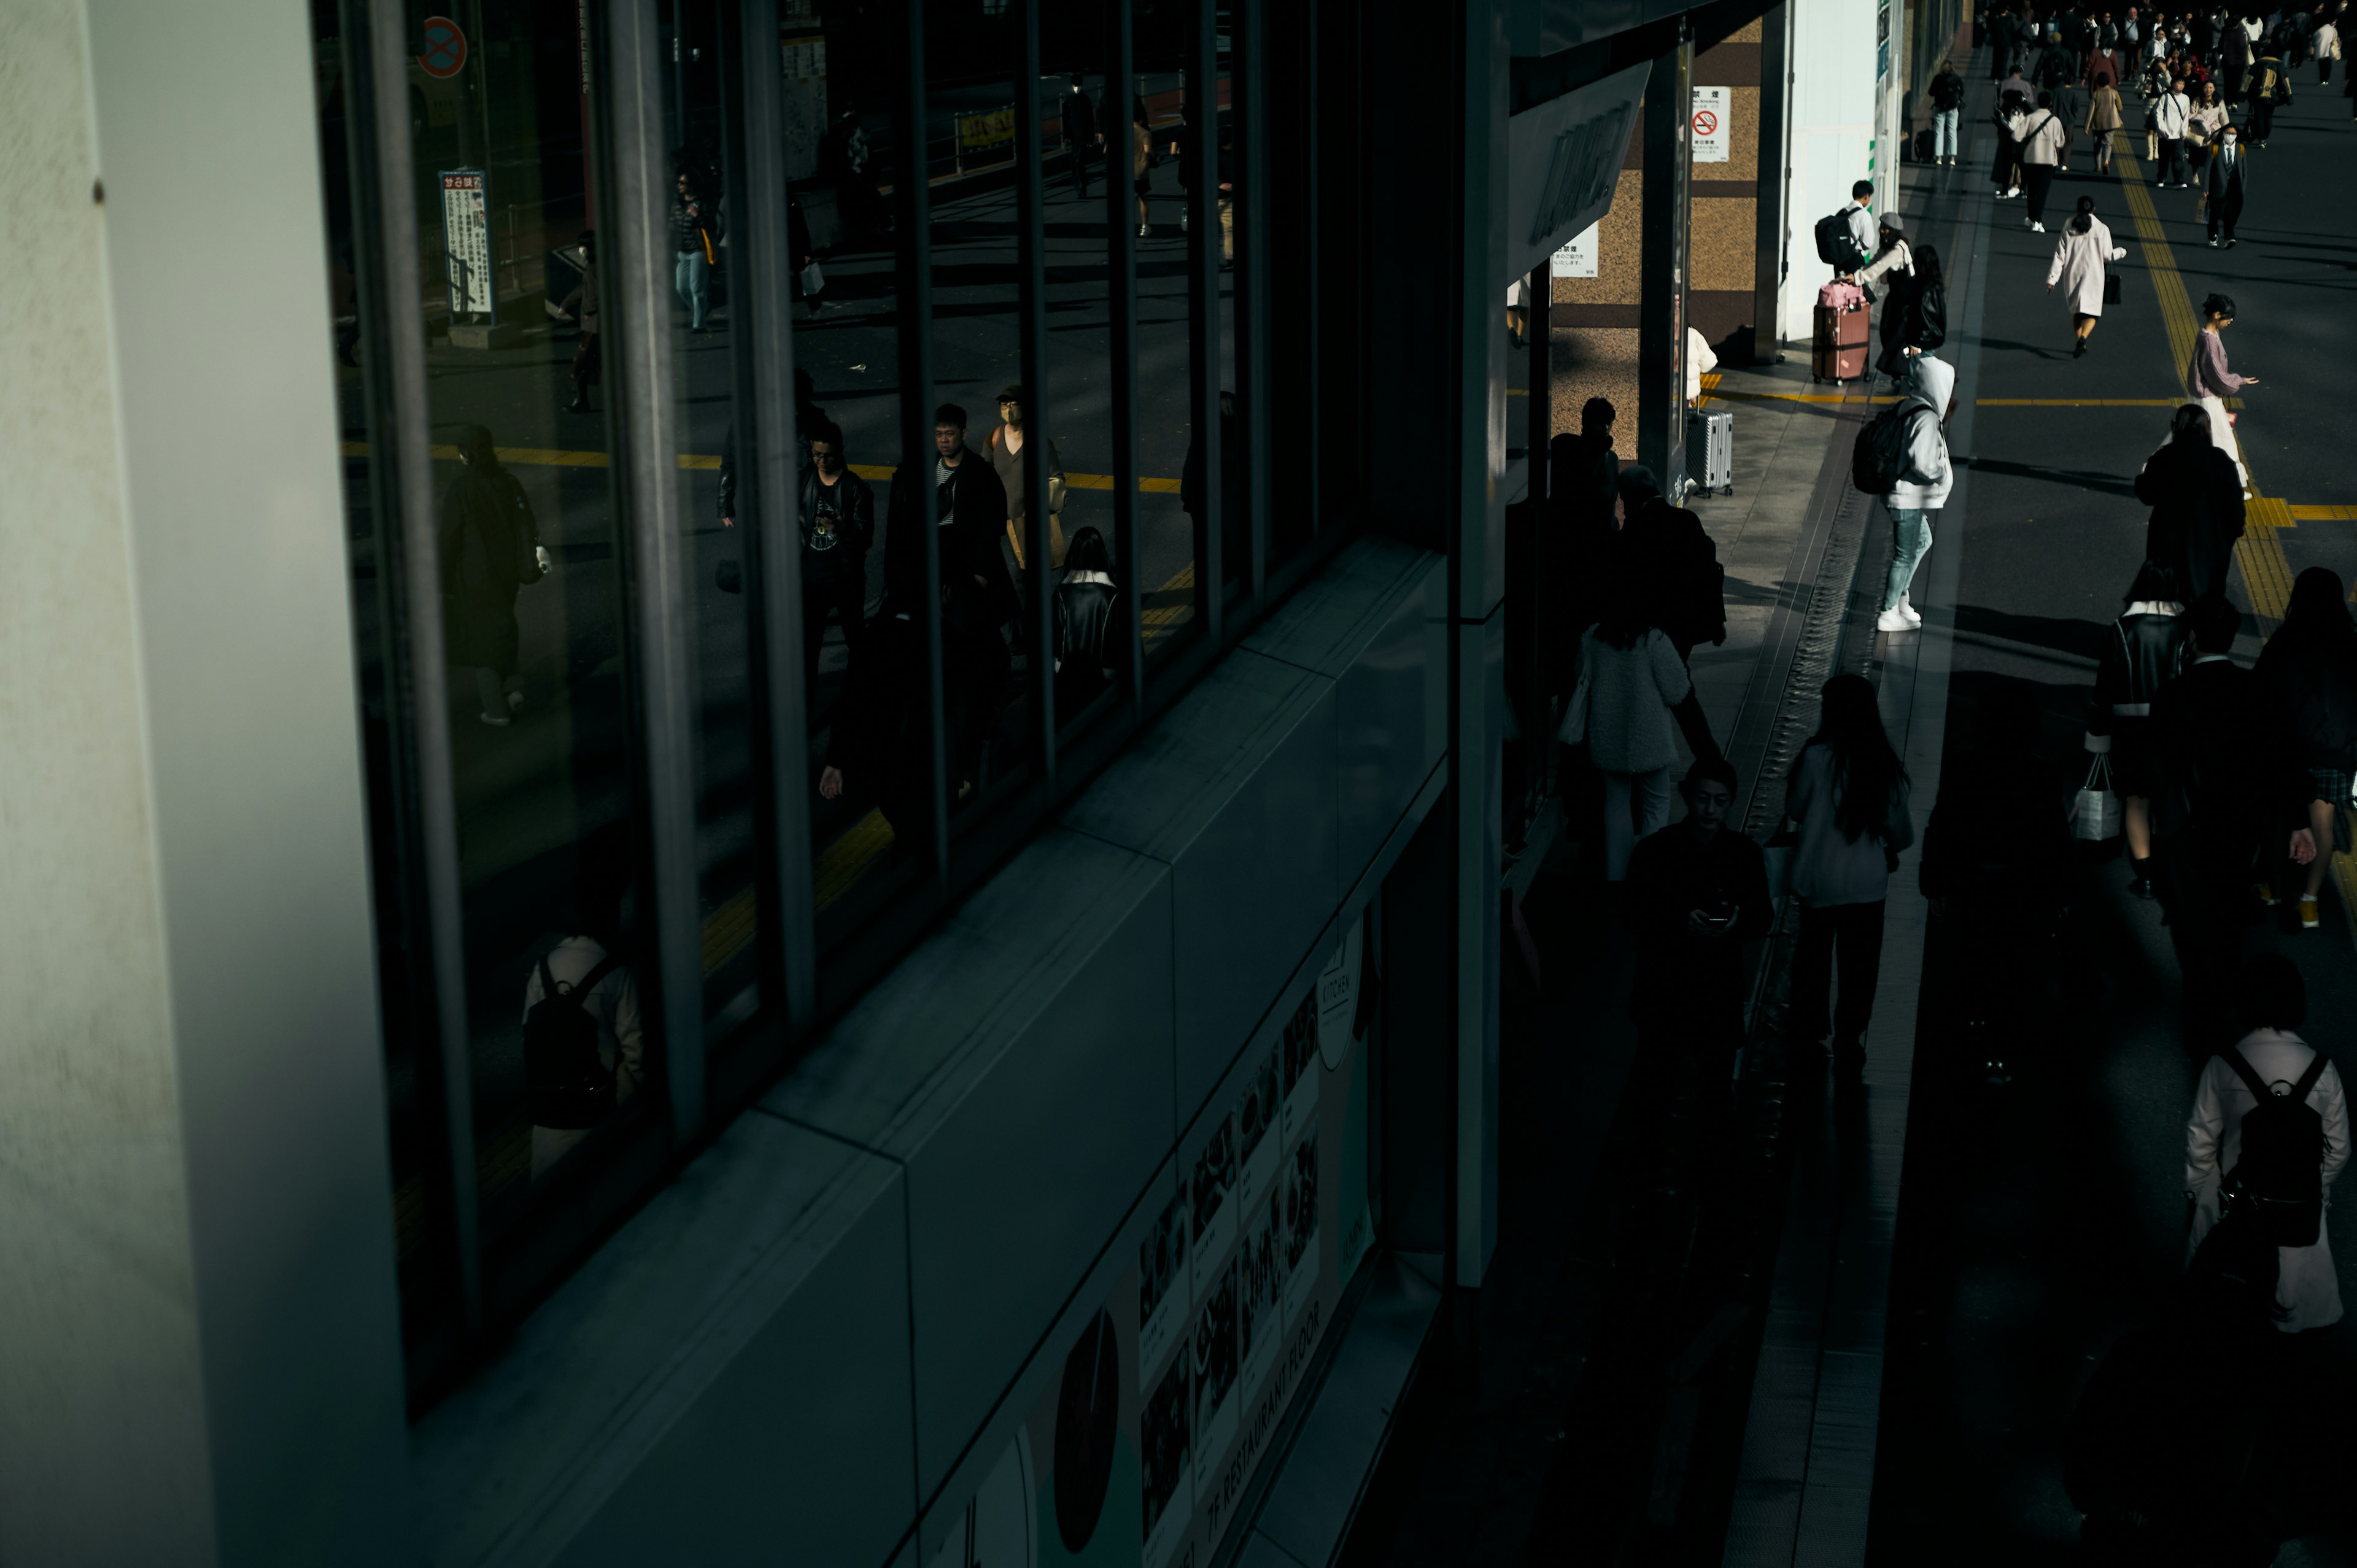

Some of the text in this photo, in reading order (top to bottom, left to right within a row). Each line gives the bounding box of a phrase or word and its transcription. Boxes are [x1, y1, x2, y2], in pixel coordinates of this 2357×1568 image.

[1322, 973, 1350, 1003] KITCHEN
[1207, 1492, 1220, 1542] 7F
[1223, 1368, 1287, 1511] RESTAURANT
[1289, 1300, 1320, 1381] FLOOR
